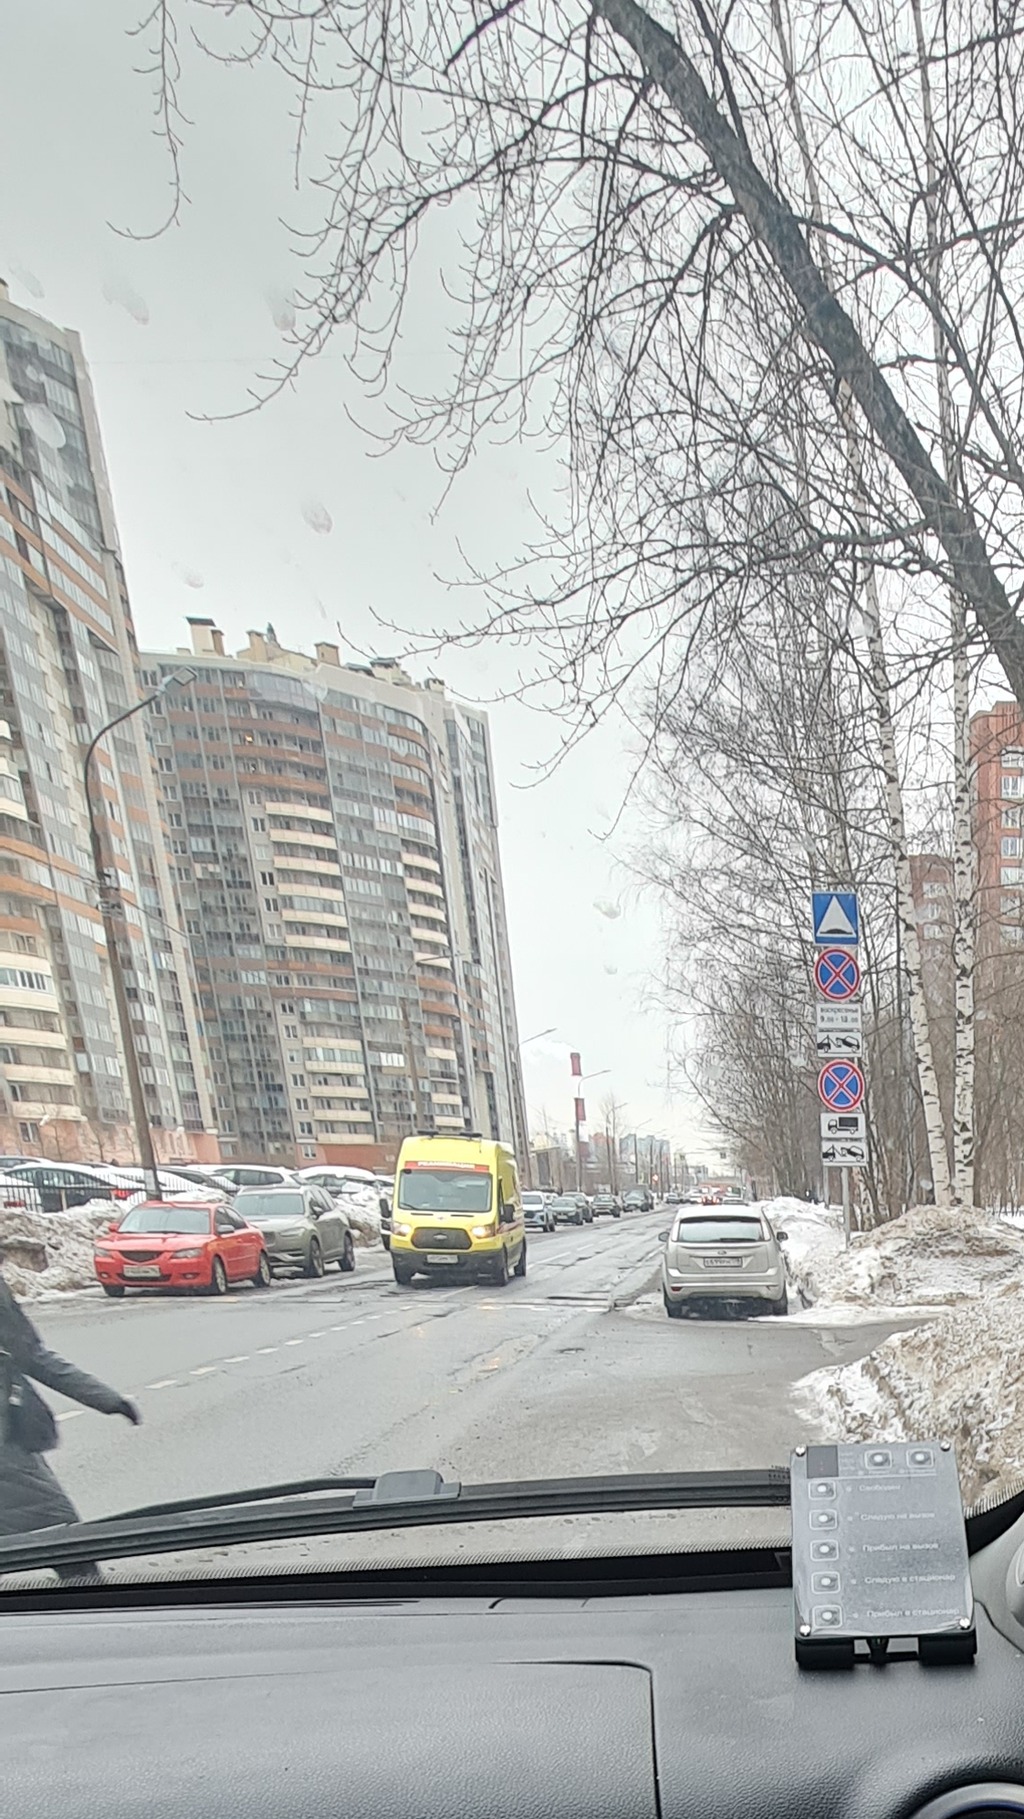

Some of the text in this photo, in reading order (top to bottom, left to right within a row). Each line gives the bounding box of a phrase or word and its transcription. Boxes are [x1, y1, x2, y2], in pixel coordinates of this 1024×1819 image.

[863, 1543, 897, 1552] Прибыл
[912, 1542, 939, 1550] вызов
[909, 1574, 956, 1583] стационар
[867, 1610, 902, 1618] Прибыл
[912, 1608, 960, 1617] стационар
